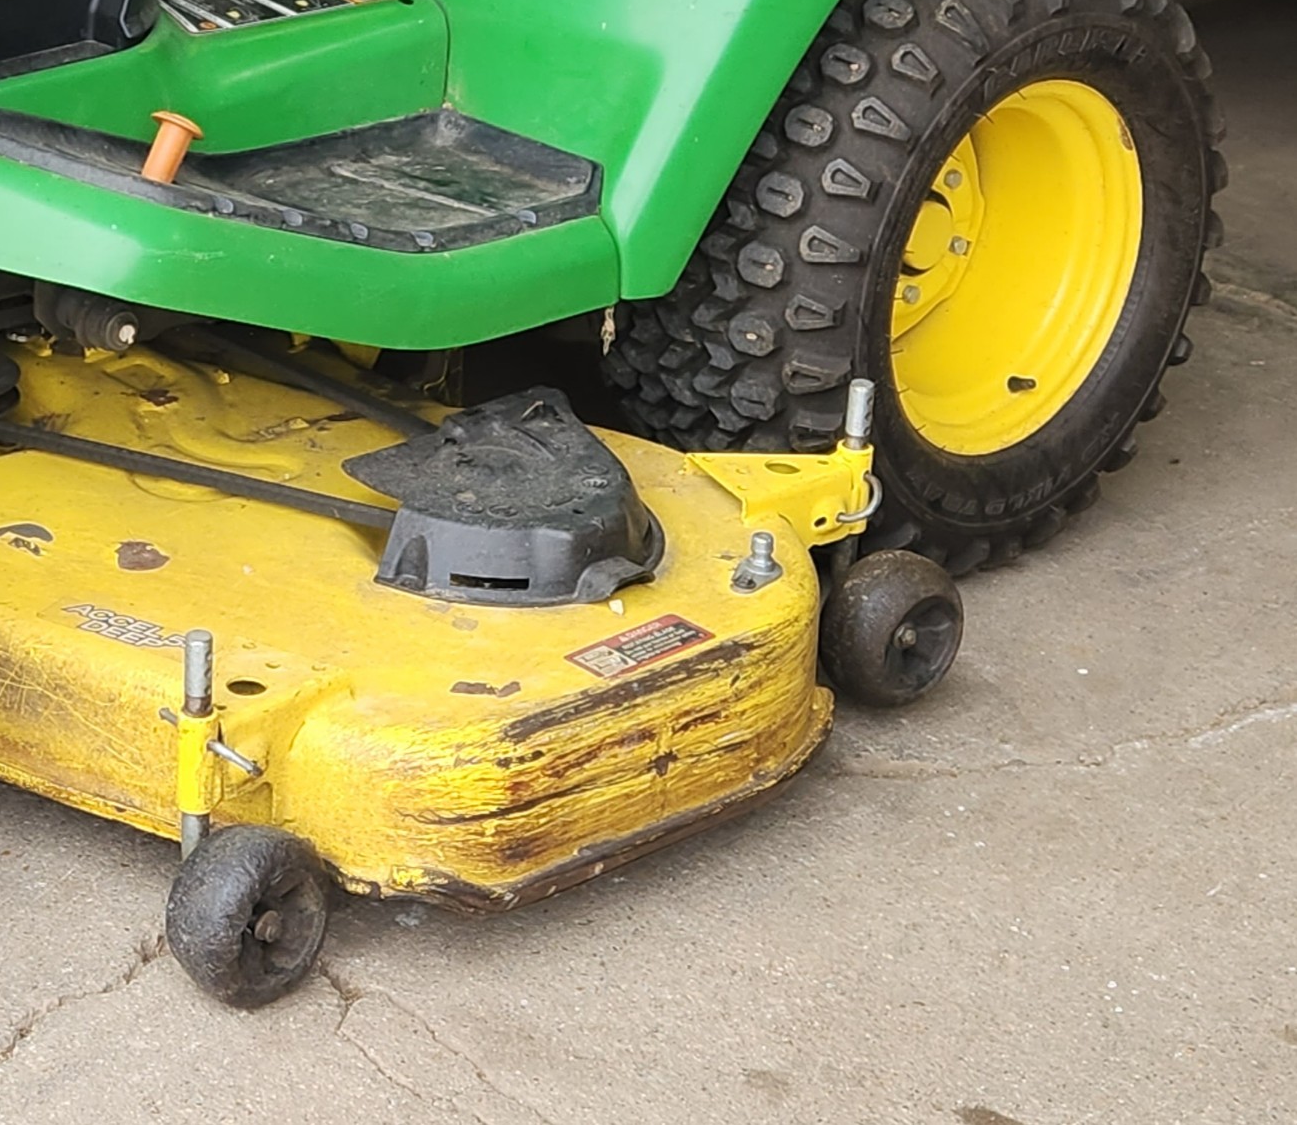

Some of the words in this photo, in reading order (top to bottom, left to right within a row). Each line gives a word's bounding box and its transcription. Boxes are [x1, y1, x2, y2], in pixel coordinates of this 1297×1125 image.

[61, 604, 164, 639] ACCEL
[76, 619, 164, 648] DEEP
[164, 633, 187, 648] 5
